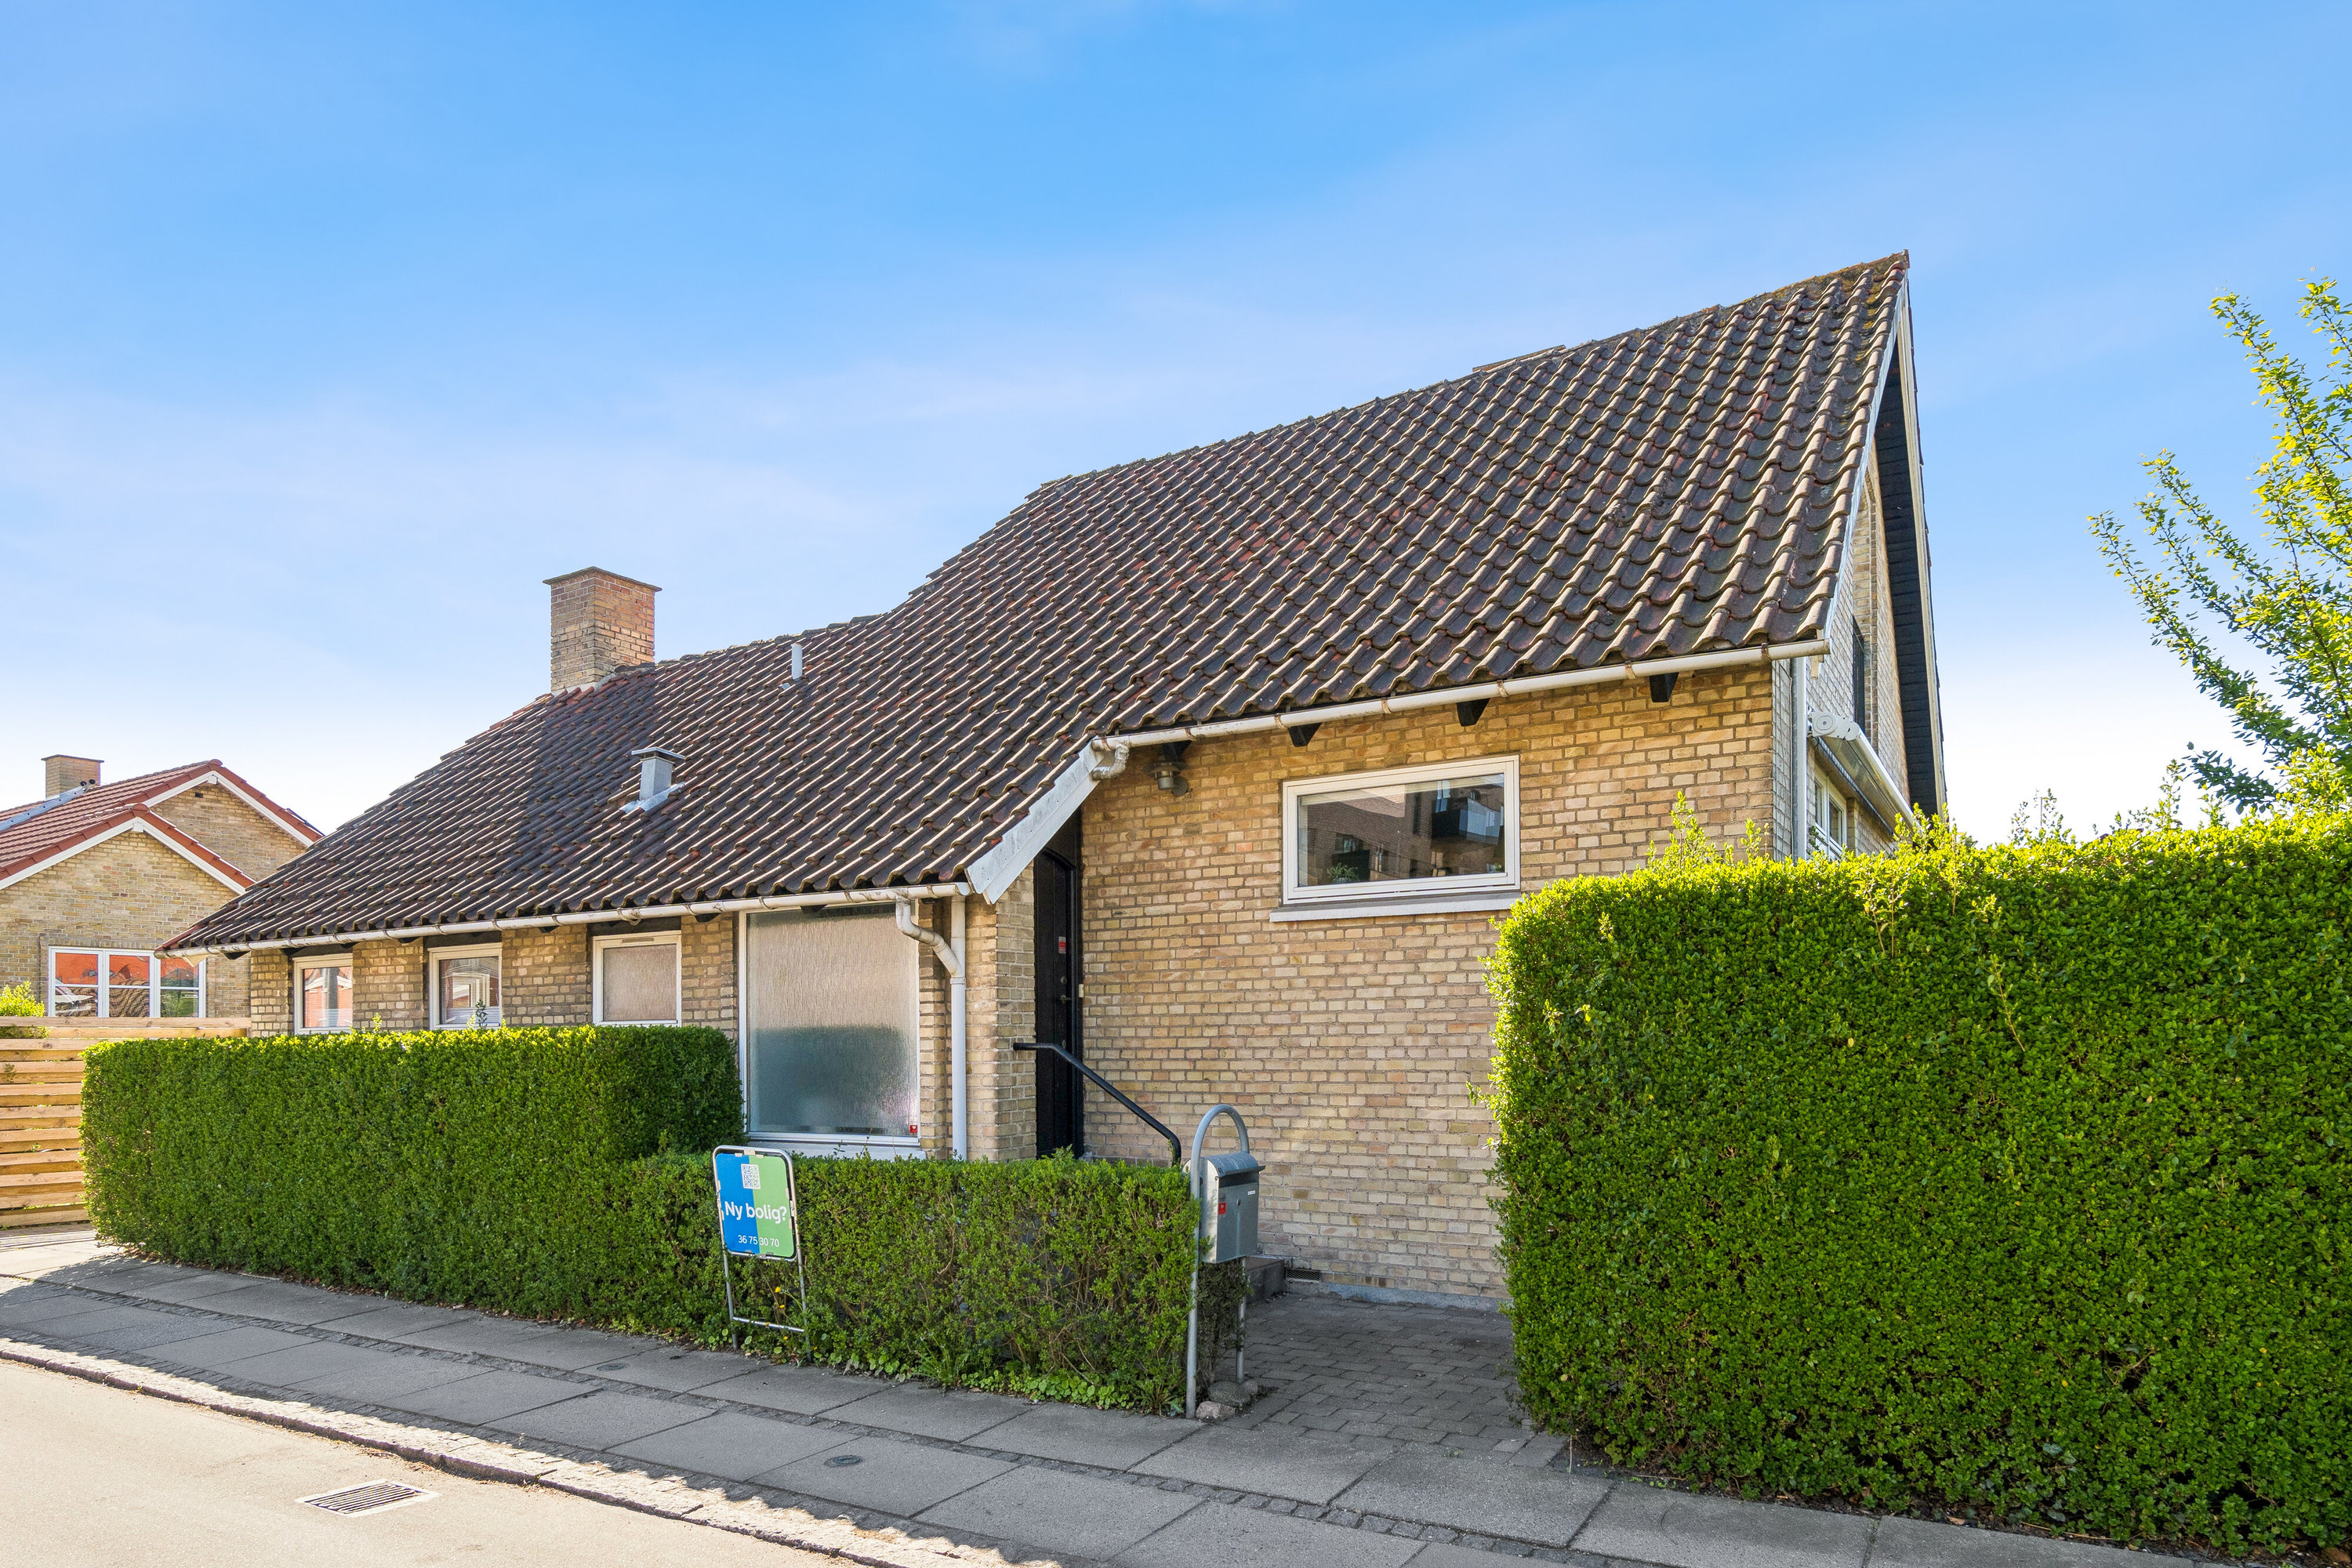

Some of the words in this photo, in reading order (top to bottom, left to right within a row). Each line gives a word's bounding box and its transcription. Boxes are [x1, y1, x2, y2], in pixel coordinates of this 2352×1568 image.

[724, 1200, 742, 1221] Ny
[746, 1203, 787, 1224] bolig?
[738, 1234, 747, 1244] 36
[749, 1236, 758, 1245] 75
[759, 1236, 768, 1247] 30
[770, 1238, 779, 1247] 70
